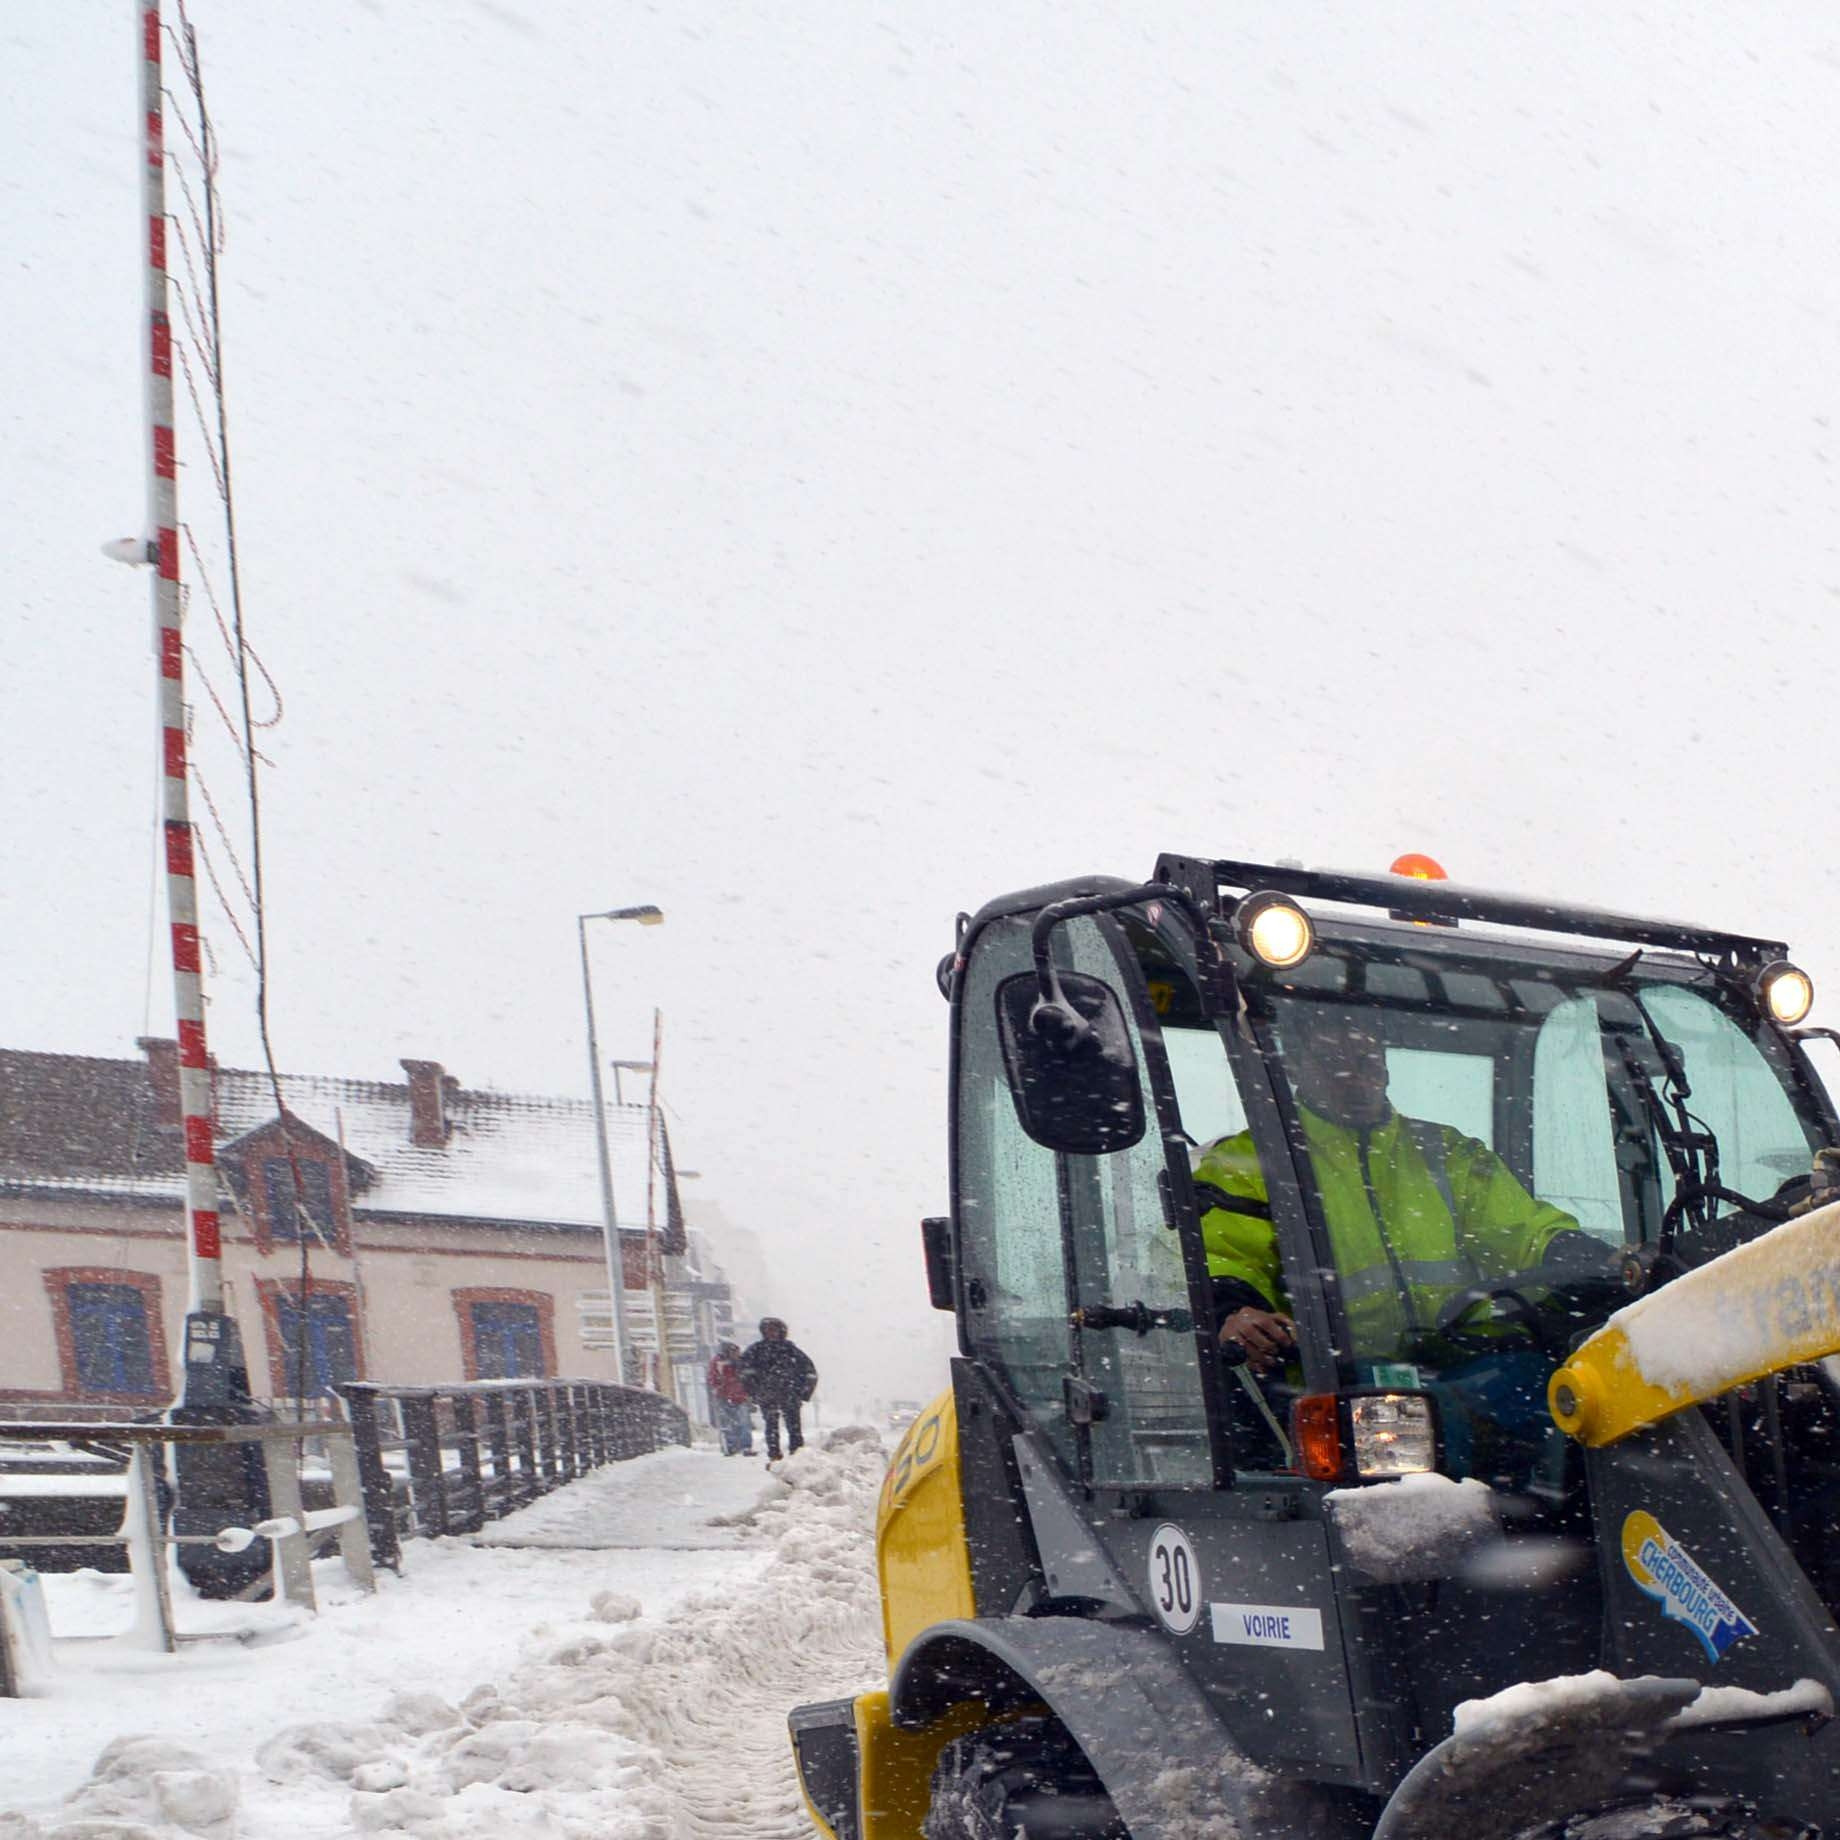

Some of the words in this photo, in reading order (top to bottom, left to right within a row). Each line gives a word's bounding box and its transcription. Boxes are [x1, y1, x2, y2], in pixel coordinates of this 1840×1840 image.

[1155, 1544, 1193, 1614] 30
[1641, 1540, 1720, 1634] CHERBOURG
[1242, 1613, 1292, 1640] VOIRIE
